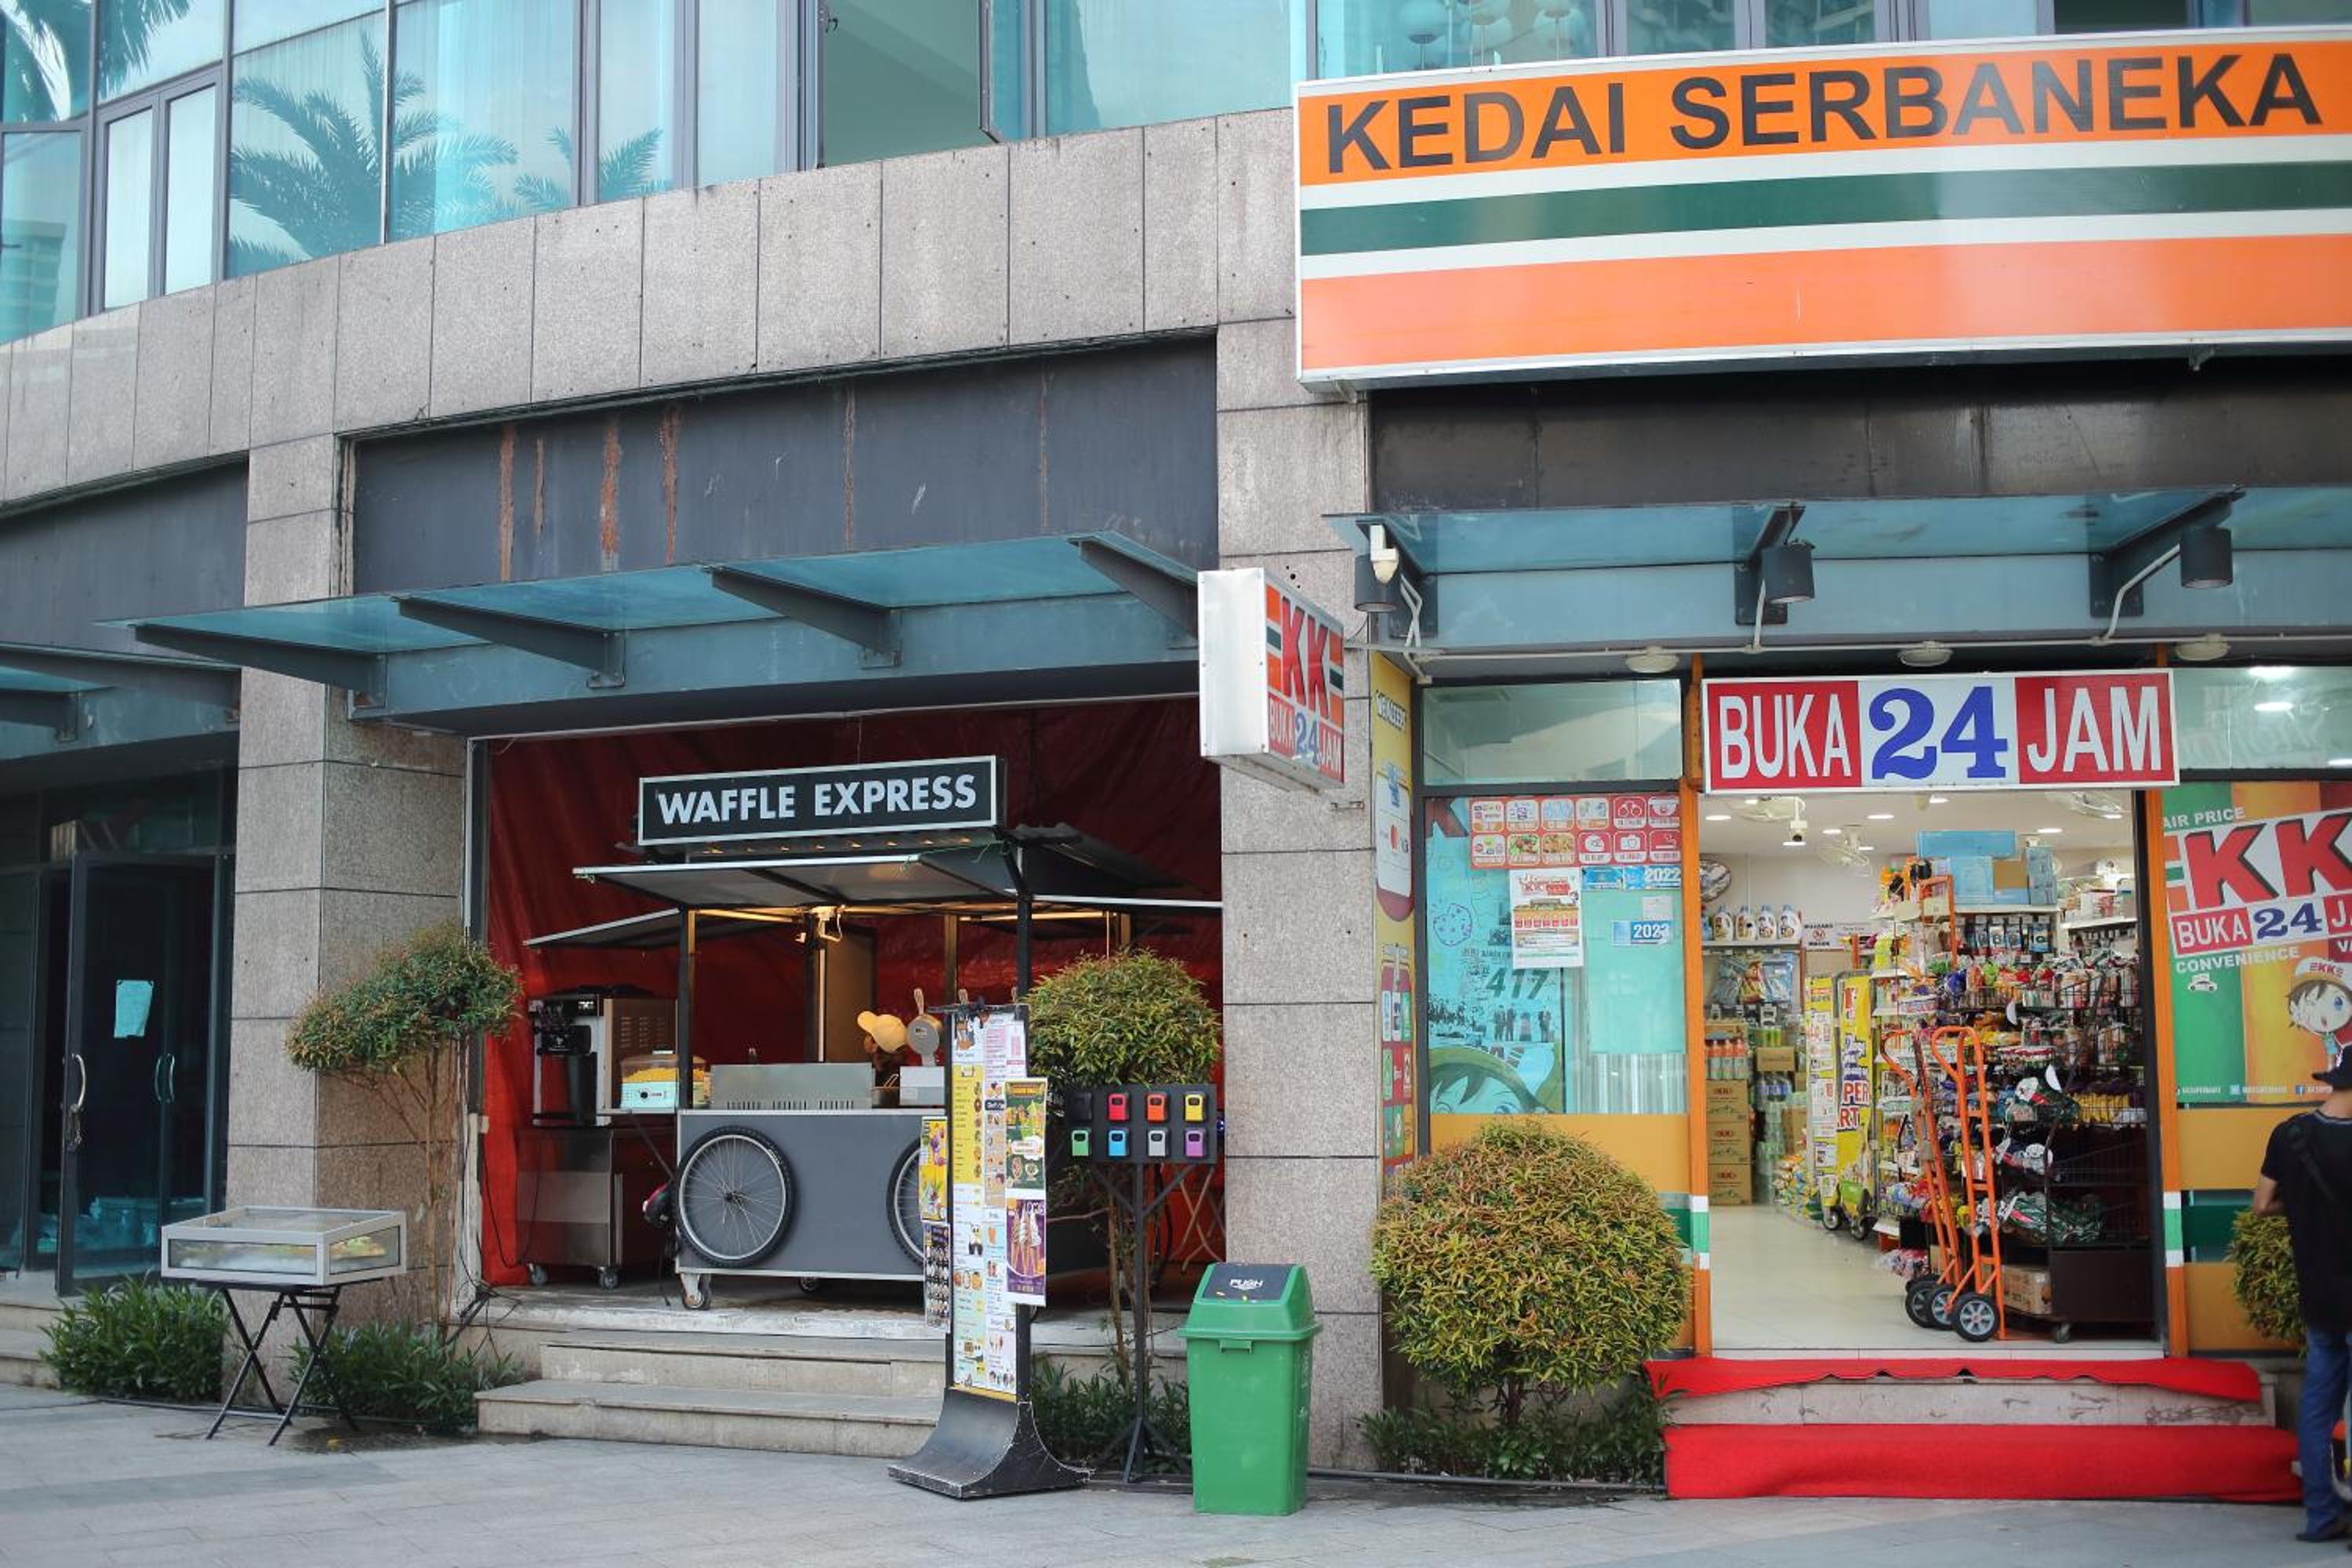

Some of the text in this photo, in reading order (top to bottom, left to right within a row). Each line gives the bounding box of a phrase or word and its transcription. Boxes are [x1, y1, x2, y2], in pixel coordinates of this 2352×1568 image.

[1327, 53, 2322, 174] KEDAI SERBANEKA
[1281, 595, 1330, 720] KK
[1270, 700, 1295, 750] BUKA
[1295, 711, 1319, 766] 24
[1319, 728, 1341, 776] JAM
[1719, 685, 2163, 780] BUKA 24 JAM
[657, 774, 976, 824] WAFFLE EXPRESS
[2194, 807, 2246, 825] PRICE
[1645, 866, 1681, 882] 2022
[2184, 811, 2352, 910] KK
[1633, 924, 1669, 939] 2023
[2177, 899, 2352, 949] BUKA 24 J
[2176, 946, 2300, 973] CONVENIENCE
[1838, 1106, 1859, 1129] RT
[1229, 1279, 1263, 1289] PUSH
